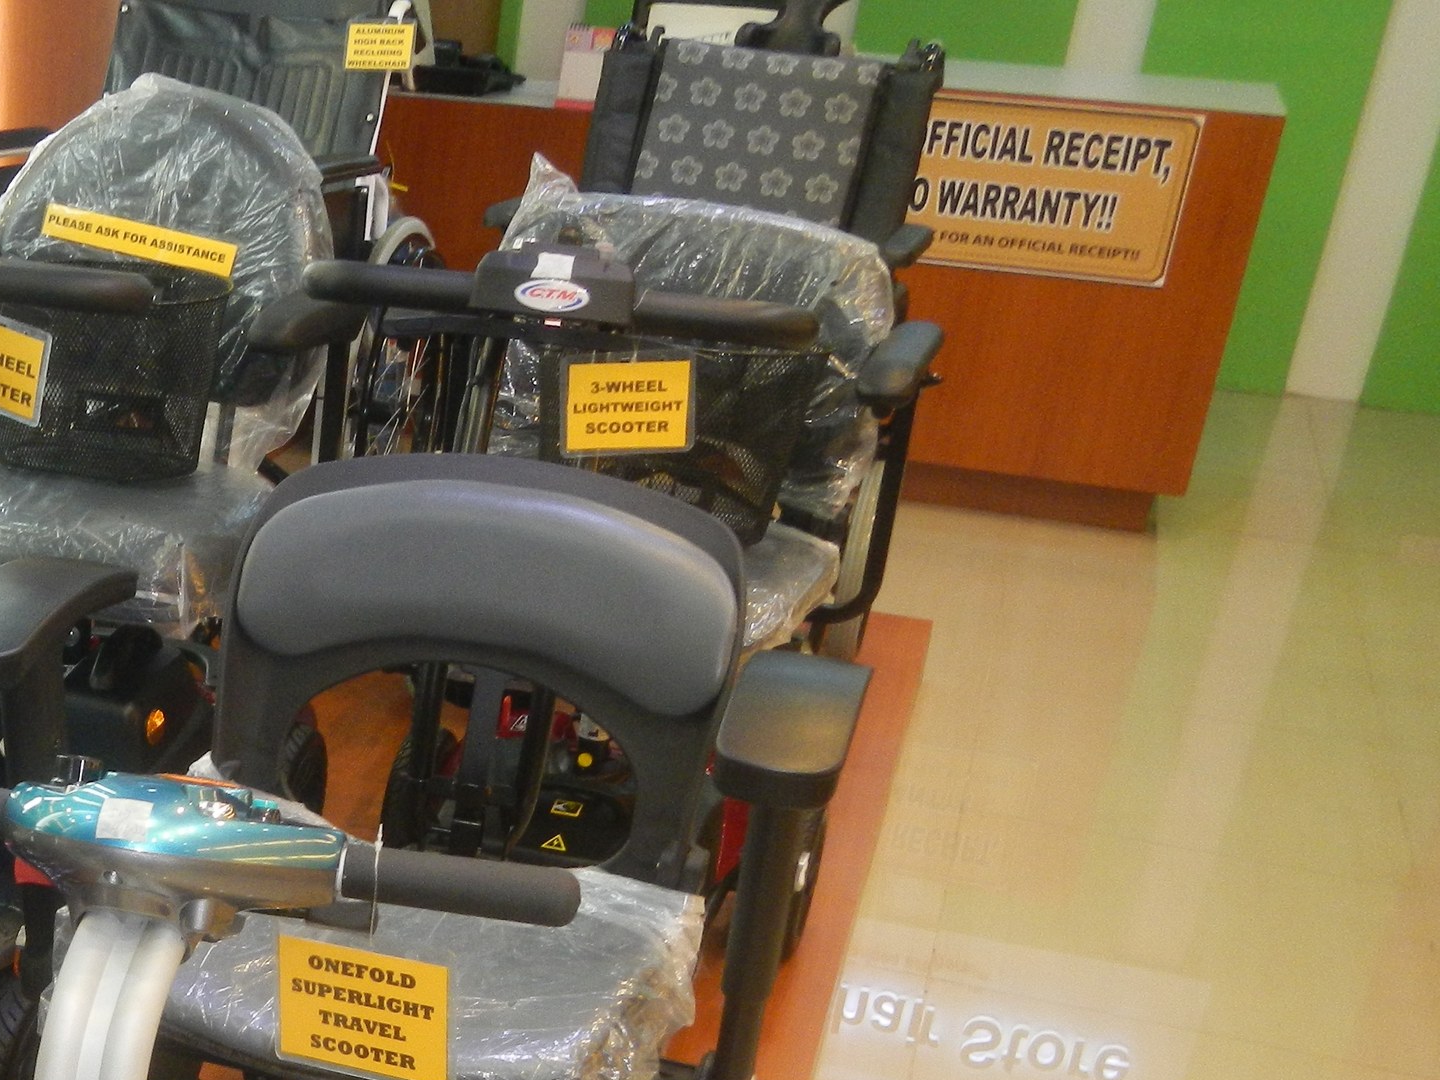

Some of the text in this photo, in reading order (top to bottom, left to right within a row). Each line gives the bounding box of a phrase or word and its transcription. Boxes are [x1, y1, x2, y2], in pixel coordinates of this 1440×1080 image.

[924, 120, 1172, 184] FFICIAL RECEIPT,
[937, 179, 1118, 230] WARRANTY!!
[48, 215, 226, 263] PLEASE ASK FOR ASSISTANCE
[940, 231, 968, 245] FOR
[972, 234, 994, 247] AN
[998, 235, 1063, 254] OFFICIAL
[591, 380, 667, 394] 3-WHEEL
[573, 400, 683, 414] LIGHTWEIGHT
[585, 421, 669, 434] SCOOTER
[308, 954, 416, 989] ONEFOLD
[291, 977, 435, 1021] SUPERLIGHT
[319, 1009, 406, 1041] TRAVEL
[310, 1033, 416, 1070] SCOOTER
